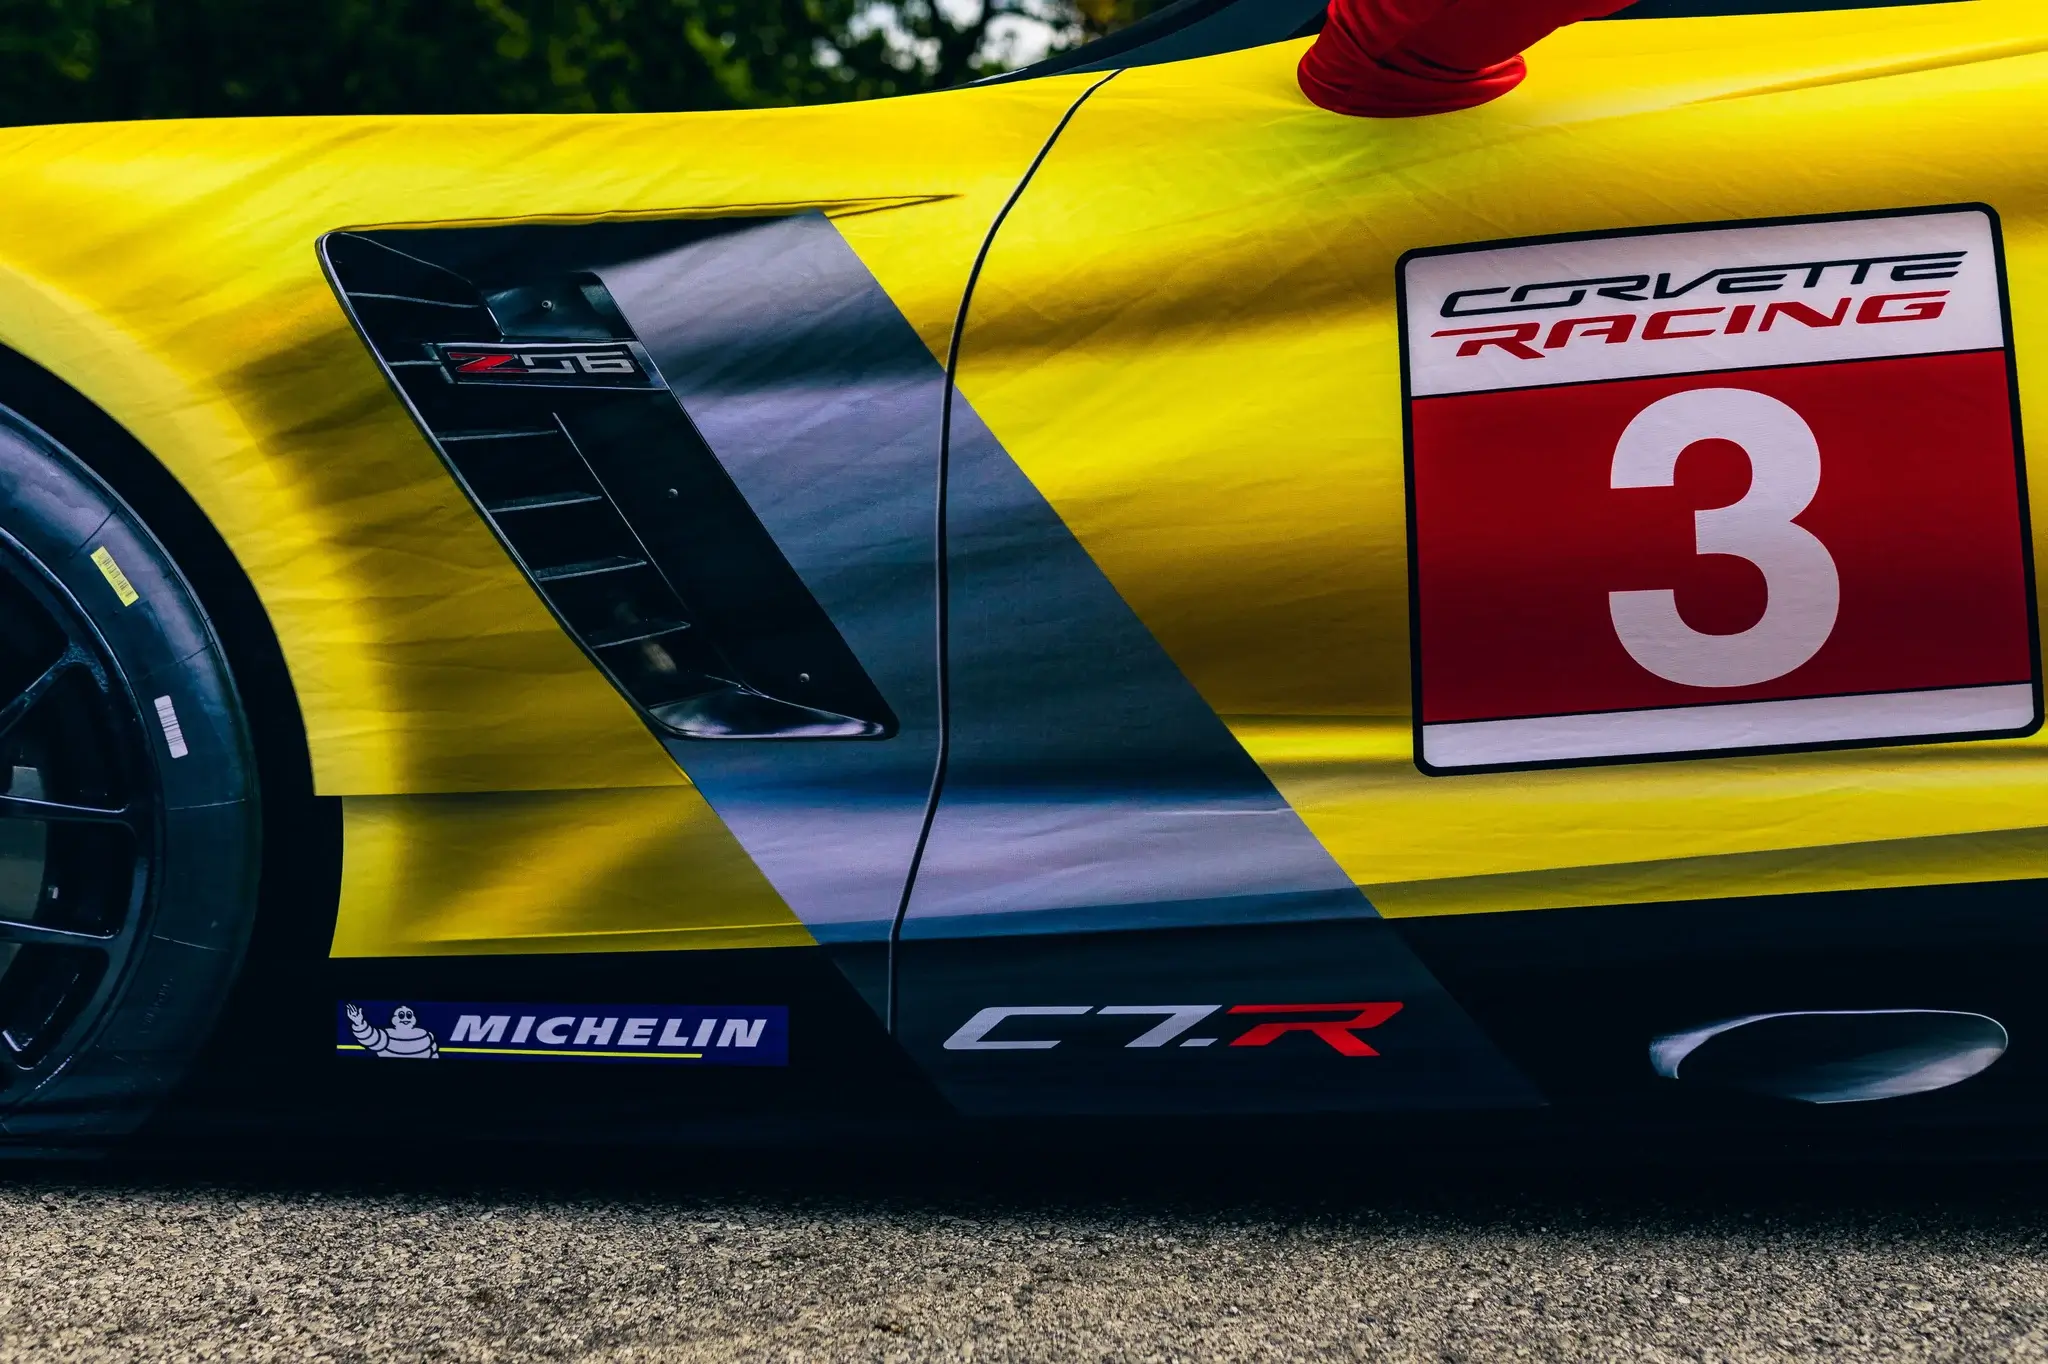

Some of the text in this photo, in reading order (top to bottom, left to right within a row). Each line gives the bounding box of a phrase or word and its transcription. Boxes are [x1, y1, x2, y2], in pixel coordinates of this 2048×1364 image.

[1439, 250, 1969, 318] CORVETTE
[1430, 290, 1951, 360] RACING
[447, 351, 636, 374] Z06
[1608, 387, 1841, 689] 3
[449, 1014, 768, 1048] MICHELIN
[943, 1001, 1404, 1057] C7.R
